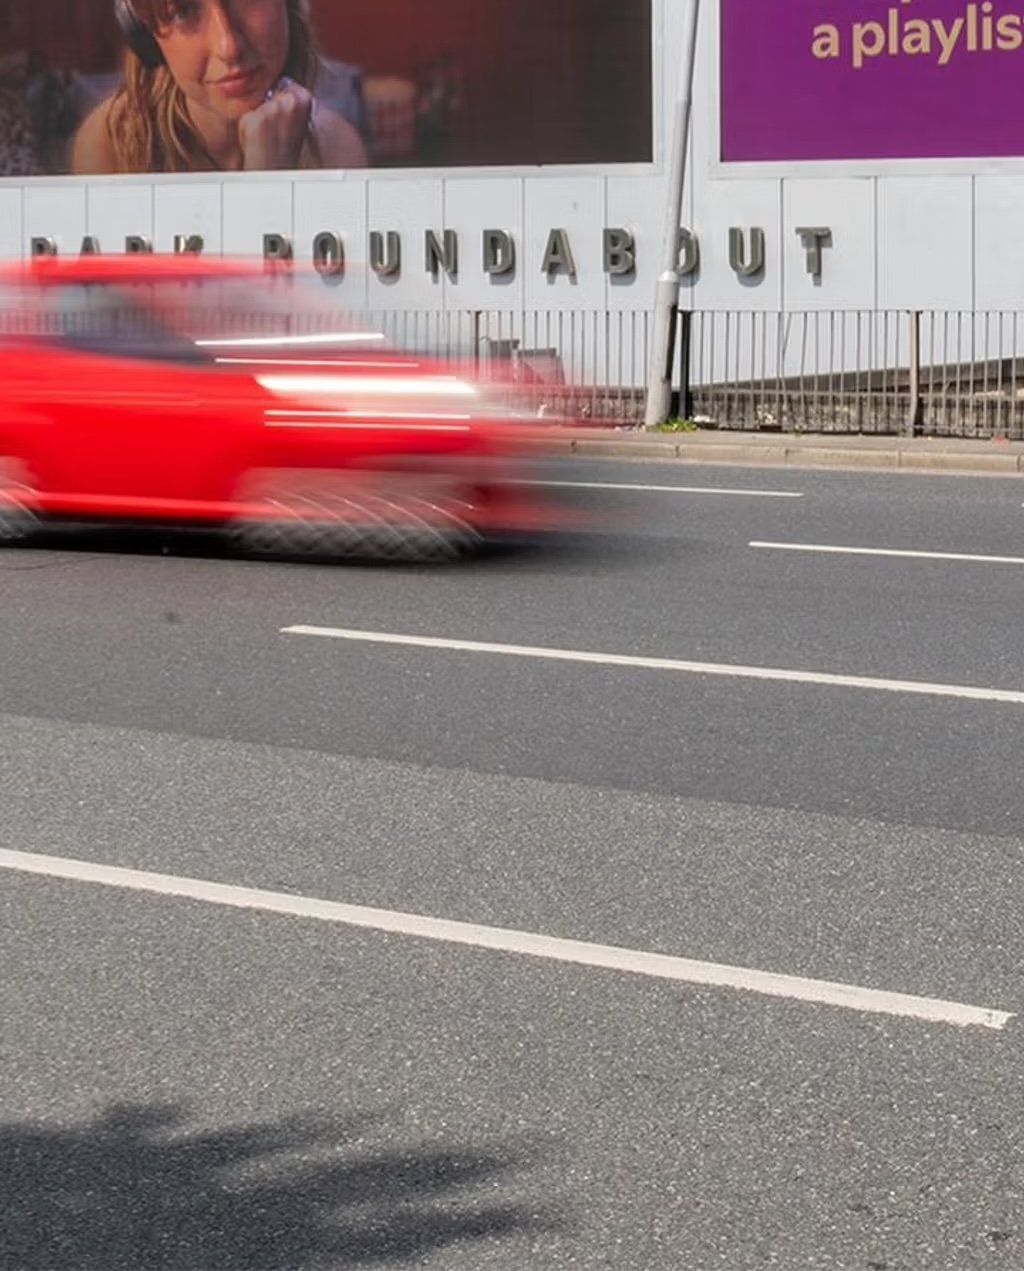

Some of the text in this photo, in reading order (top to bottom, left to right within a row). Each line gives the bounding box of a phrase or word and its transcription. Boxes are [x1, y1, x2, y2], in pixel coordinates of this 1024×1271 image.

[811, 1, 1024, 68] a playlis
[263, 227, 833, 282] ROUNDABOUT
